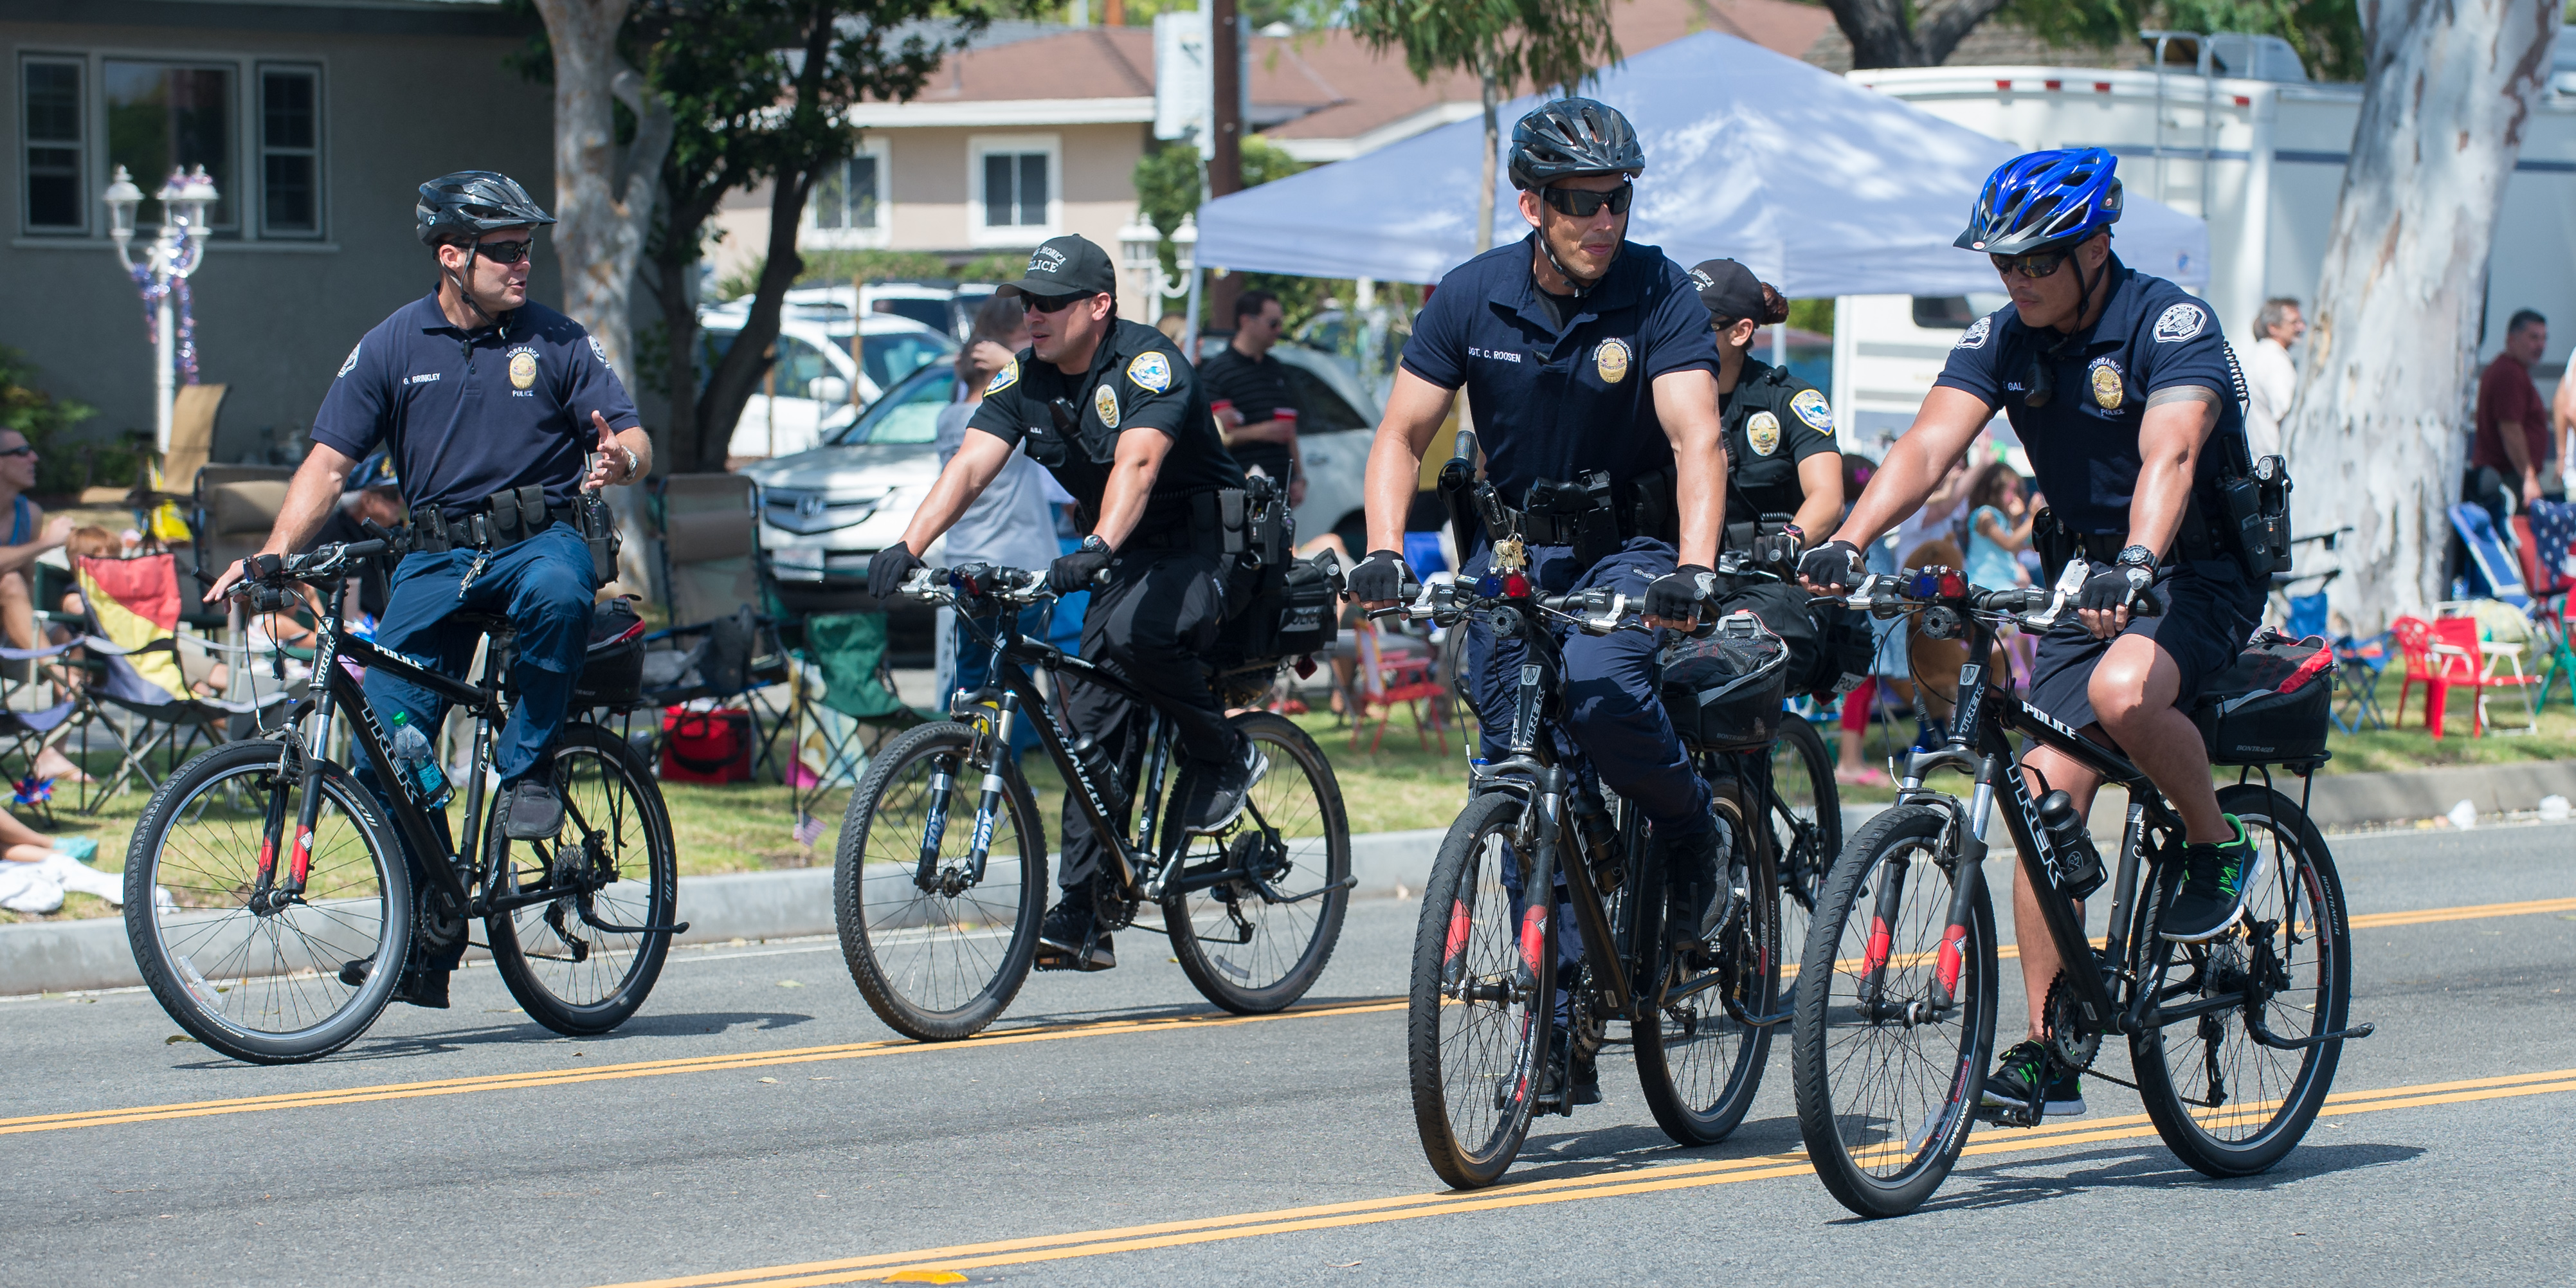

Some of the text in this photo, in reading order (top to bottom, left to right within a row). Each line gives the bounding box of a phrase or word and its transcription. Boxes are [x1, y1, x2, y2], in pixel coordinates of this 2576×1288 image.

[1039, 246, 1067, 265] MONICA
[1691, 268, 1715, 287] MONICA
[506, 346, 540, 360] TORRANCE
[1484, 350, 1491, 359] C.
[1494, 350, 1521, 363] ROOSEN
[2088, 357, 2125, 375] TORRANCE
[412, 373, 440, 383] BRINKLEY
[2101, 408, 2125, 417] POLICE
[315, 634, 336, 683] TREK
[373, 642, 424, 671] POLICE
[1522, 684, 1546, 747] TREK
[1959, 682, 1985, 733] TREK
[2022, 700, 2077, 740] POLICE
[361, 696, 421, 805] TREK
[1716, 732, 1748, 741] BONTRAGER
[2236, 745, 2275, 753] BONTRAGER
[1039, 703, 1108, 817] SPECIALIZED
[926, 805, 948, 853] FOX
[977, 807, 997, 855] FOX
[2006, 751, 2065, 890] TREK
[2321, 875, 2341, 936] BONTRAGER
[1518, 1068, 1540, 1133] BONTRAGER
[1943, 1098, 1972, 1156] BONTRAGER
